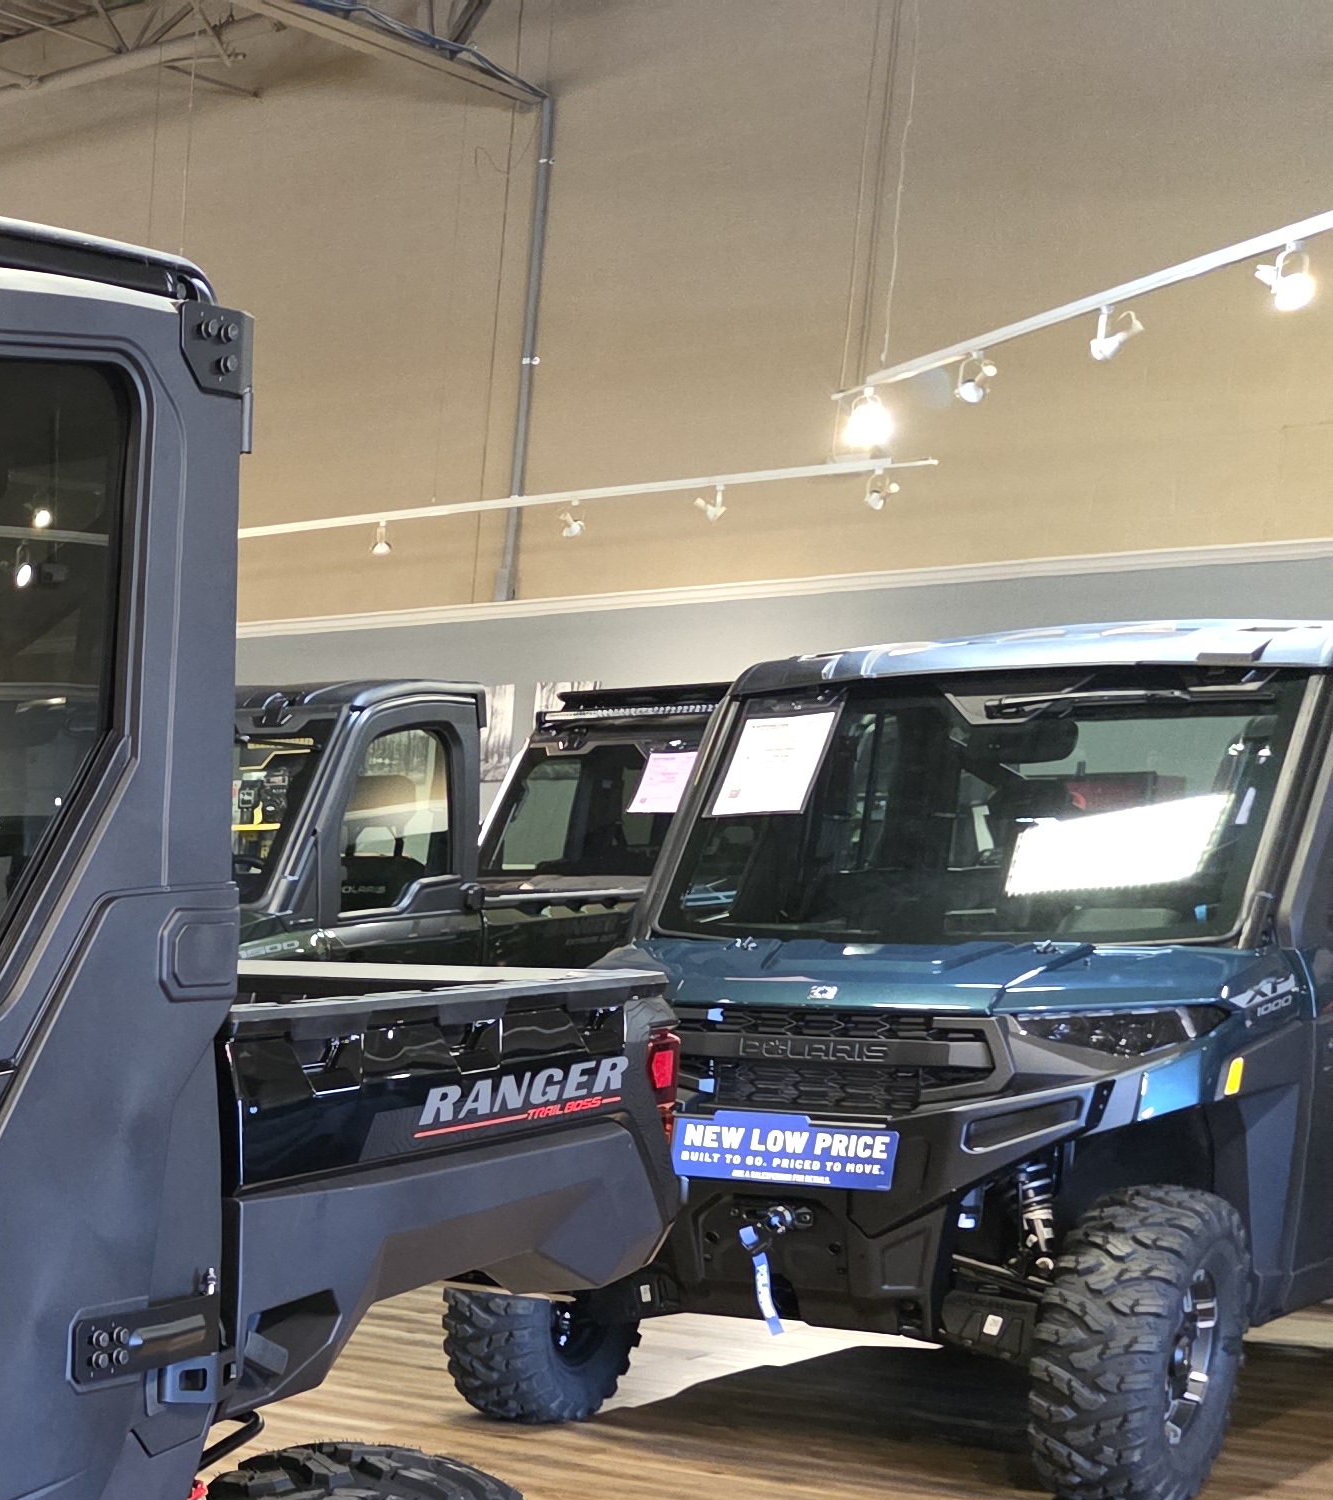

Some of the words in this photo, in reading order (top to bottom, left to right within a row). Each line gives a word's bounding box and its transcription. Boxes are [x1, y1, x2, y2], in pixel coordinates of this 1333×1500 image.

[342, 885, 386, 894] OLARIS
[1257, 995, 1293, 1017] 1000
[739, 1037, 889, 1063] POLARIS
[418, 1055, 629, 1126] RANGER
[527, 1103, 564, 1121] TRAIL
[564, 1096, 602, 1114] BOSS
[684, 1123, 745, 1150] NEW
[750, 1128, 810, 1154] LOW
[813, 1132, 890, 1160] PRICE
[680, 1150, 720, 1163] BUILT
[725, 1153, 741, 1164] TO
[772, 1157, 821, 1171] PRICED
[825, 1161, 841, 1172] TO
[845, 1162, 885, 1176] MOVE.
